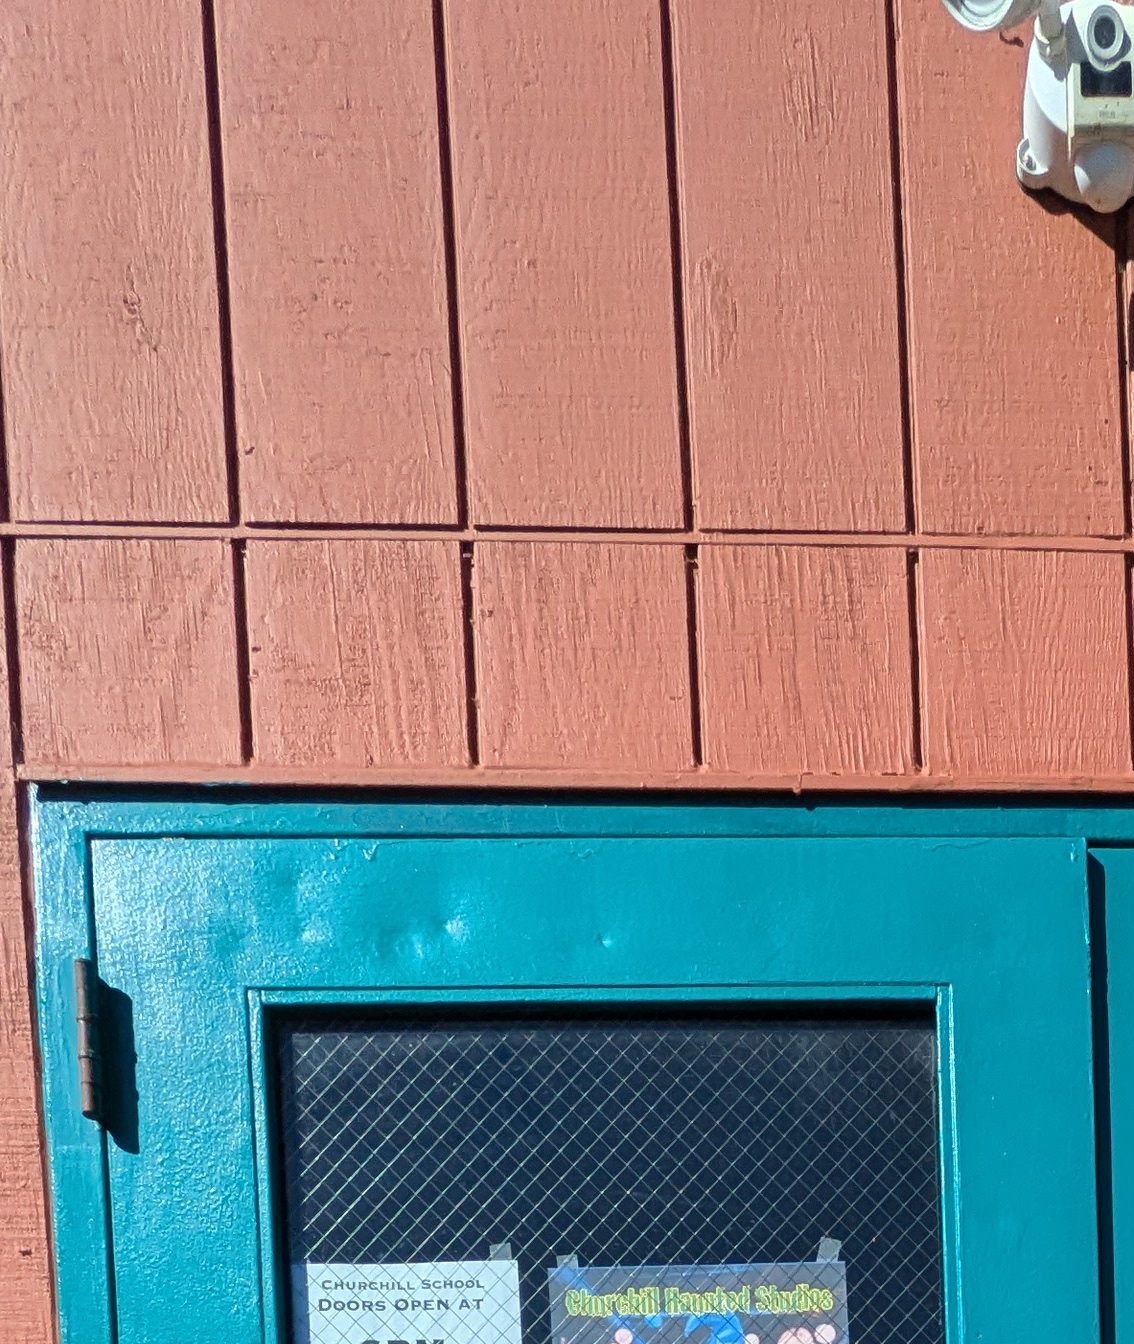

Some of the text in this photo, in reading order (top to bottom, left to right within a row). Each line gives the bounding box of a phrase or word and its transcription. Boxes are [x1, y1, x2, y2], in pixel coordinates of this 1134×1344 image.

[321, 1279, 485, 1291] CHURCHILL SCHOOL
[318, 1299, 484, 1312] DOORS OPEN AT
[564, 1283, 834, 1318] Churchill Haunted Studios
